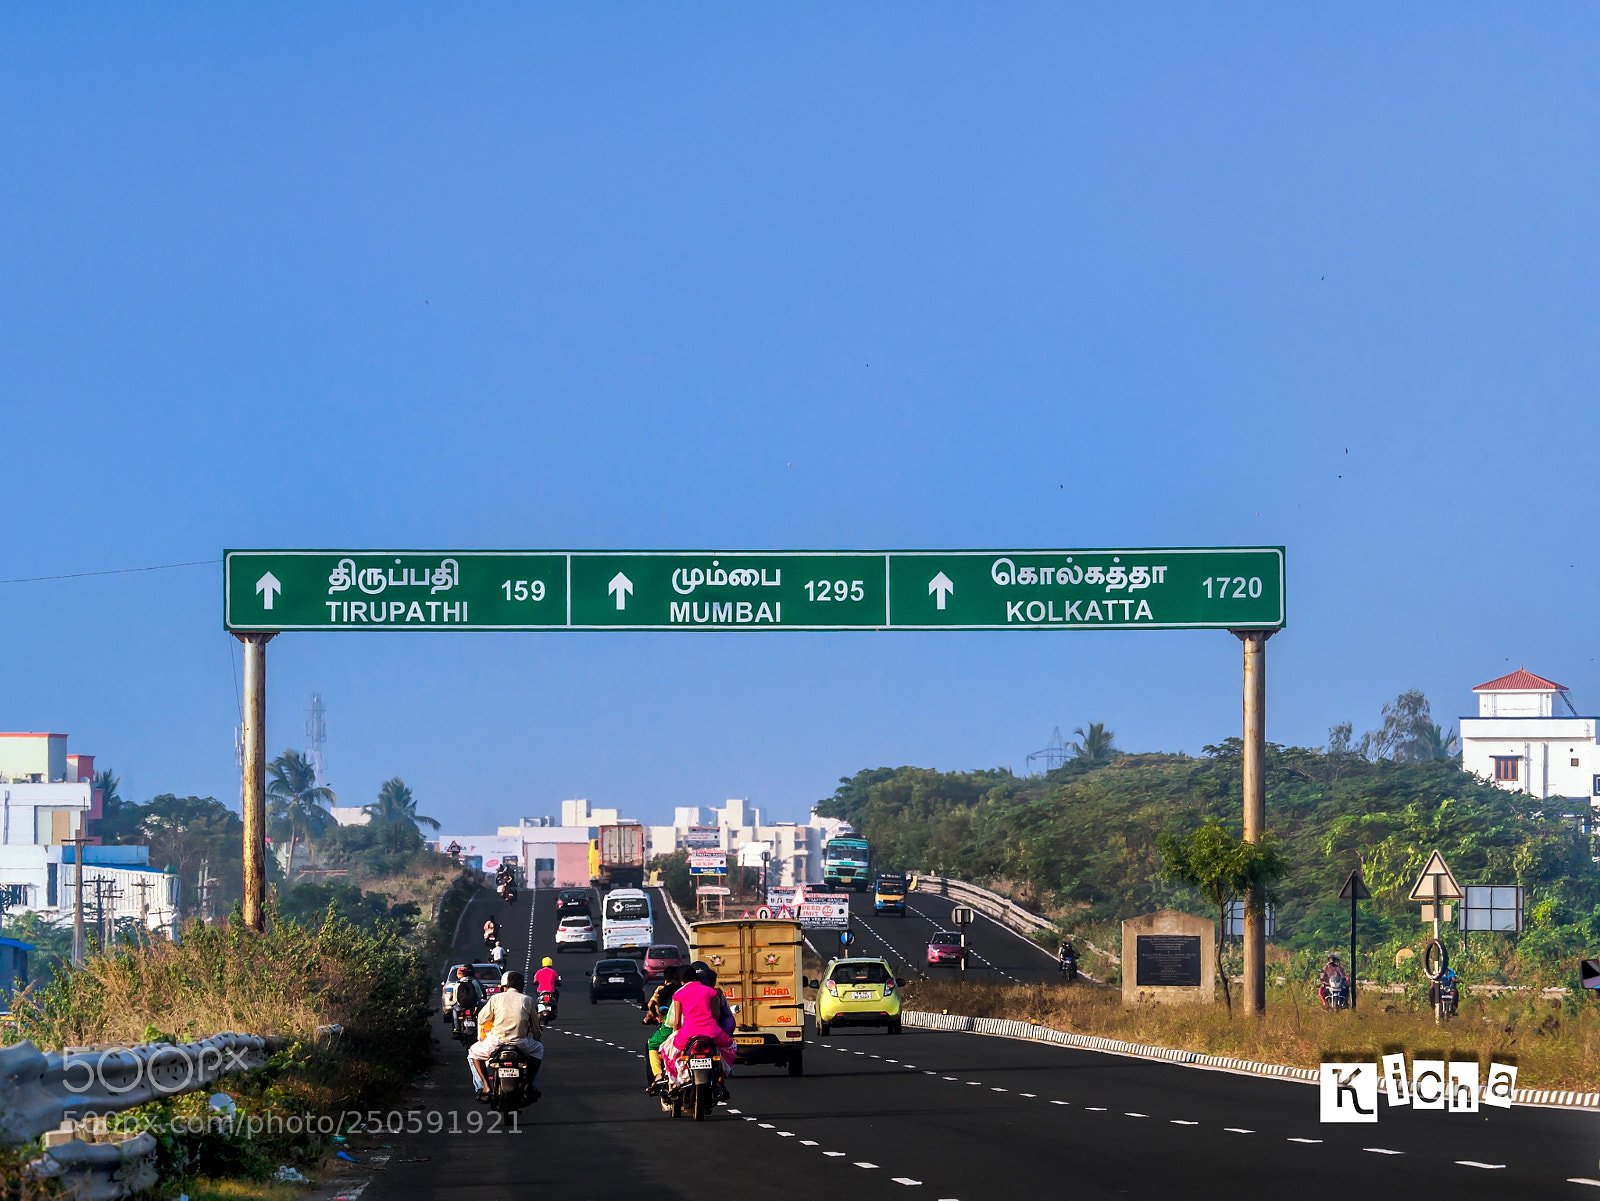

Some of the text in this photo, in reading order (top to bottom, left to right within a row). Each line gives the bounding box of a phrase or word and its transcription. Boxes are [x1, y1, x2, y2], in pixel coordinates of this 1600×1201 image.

[328, 558, 459, 594] திருப்பதி
[671, 560, 782, 594] மும்பை
[991, 557, 1168, 593] கொல்கத்தா
[501, 579, 546, 602] 159
[804, 580, 864, 602] 1295
[1202, 576, 1262, 599] 1720
[325, 601, 468, 622] TIRUPATHI
[669, 601, 782, 623] MUMBAI
[1005, 600, 1154, 622] KOLKATTA
